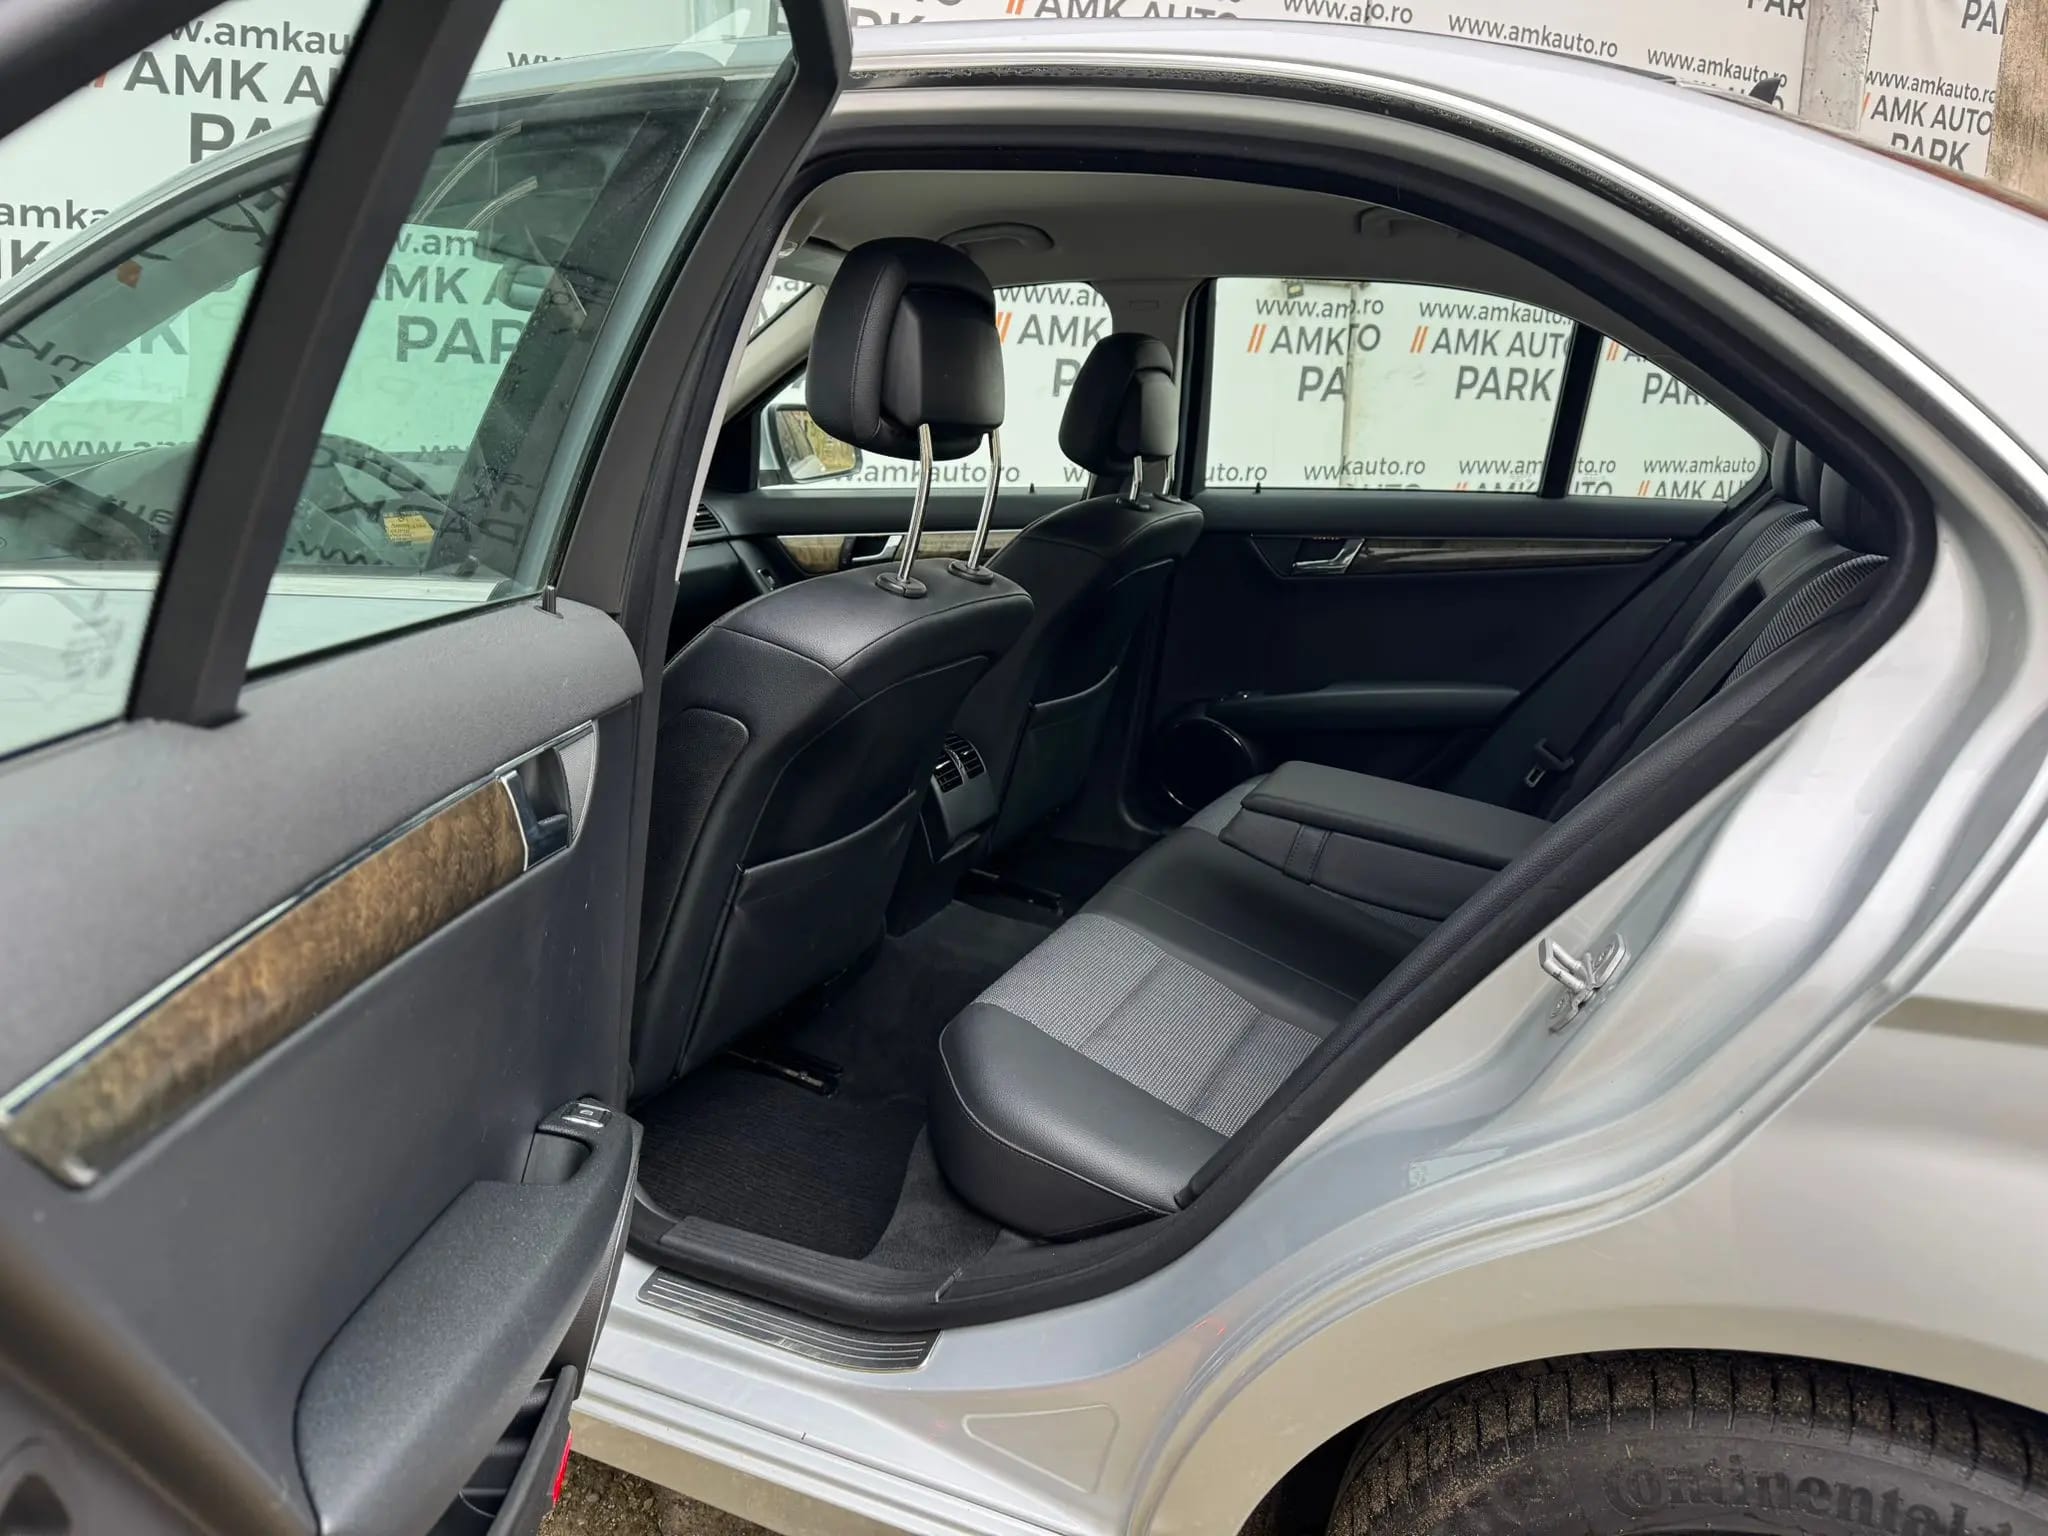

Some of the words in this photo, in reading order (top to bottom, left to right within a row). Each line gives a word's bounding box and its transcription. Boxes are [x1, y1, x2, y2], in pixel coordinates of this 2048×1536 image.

[1448, 14, 1618, 57] www.amkauto.ro
[1961, 0, 2005, 35] PA
[123, 51, 269, 103] AMK
[1870, 94, 1928, 128] AMK
[1930, 104, 1993, 136] AUTO
[377, 264, 470, 304] MK
[1017, 313, 1107, 347] AMK
[1431, 327, 1502, 357] AMK
[1506, 331, 1571, 358] AUT
[1455, 365, 1555, 402] PARK
